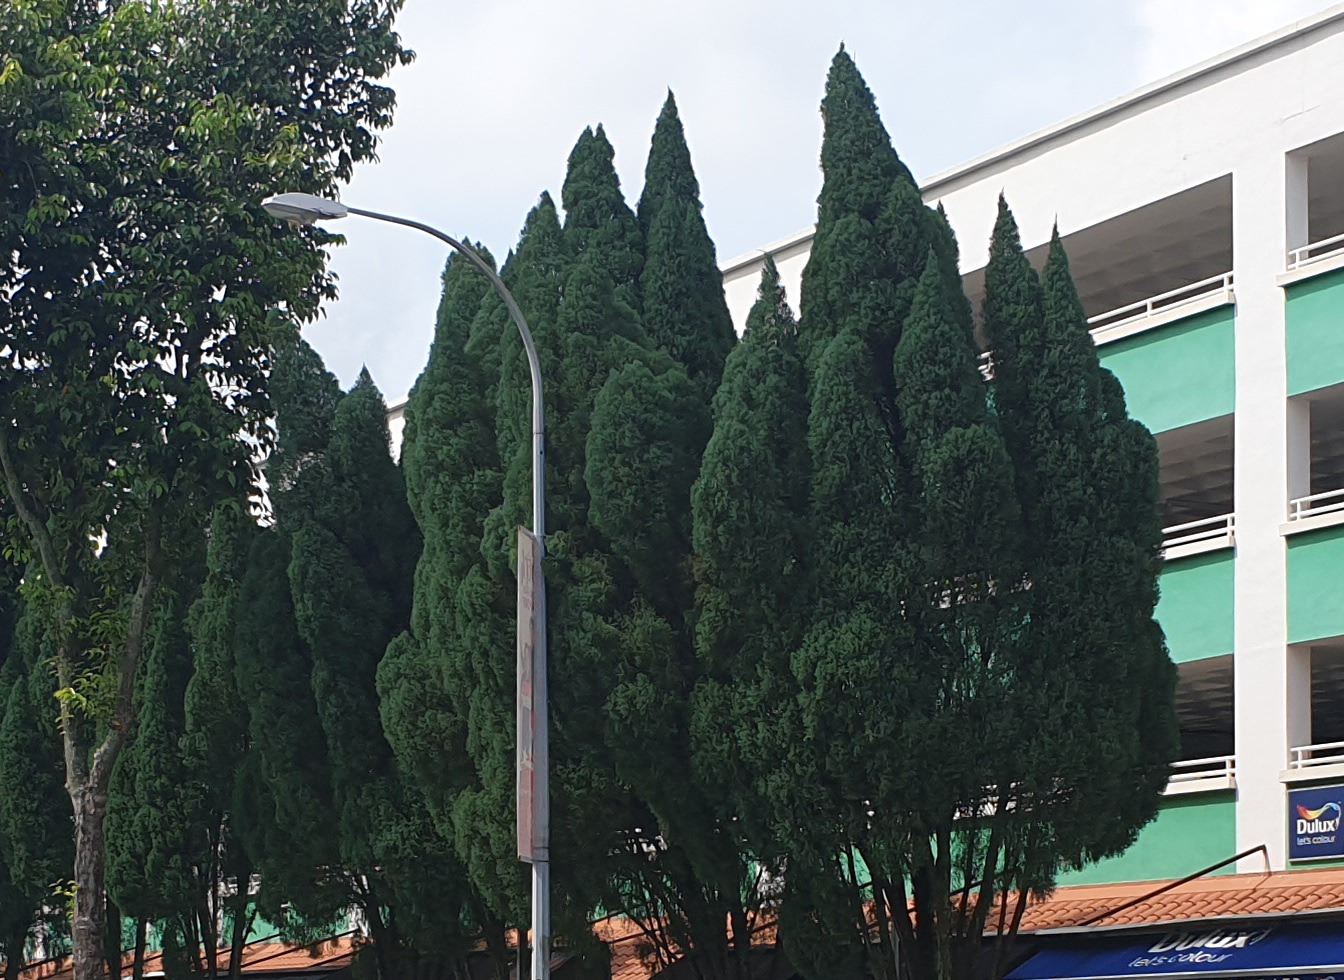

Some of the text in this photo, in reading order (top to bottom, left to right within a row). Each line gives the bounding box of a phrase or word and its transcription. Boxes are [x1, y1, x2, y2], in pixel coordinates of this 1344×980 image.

[1297, 819, 1335, 834] Dulux
[1312, 835, 1336, 844] colour
[1148, 929, 1250, 953] Dulux
[1168, 951, 1233, 963] colour
